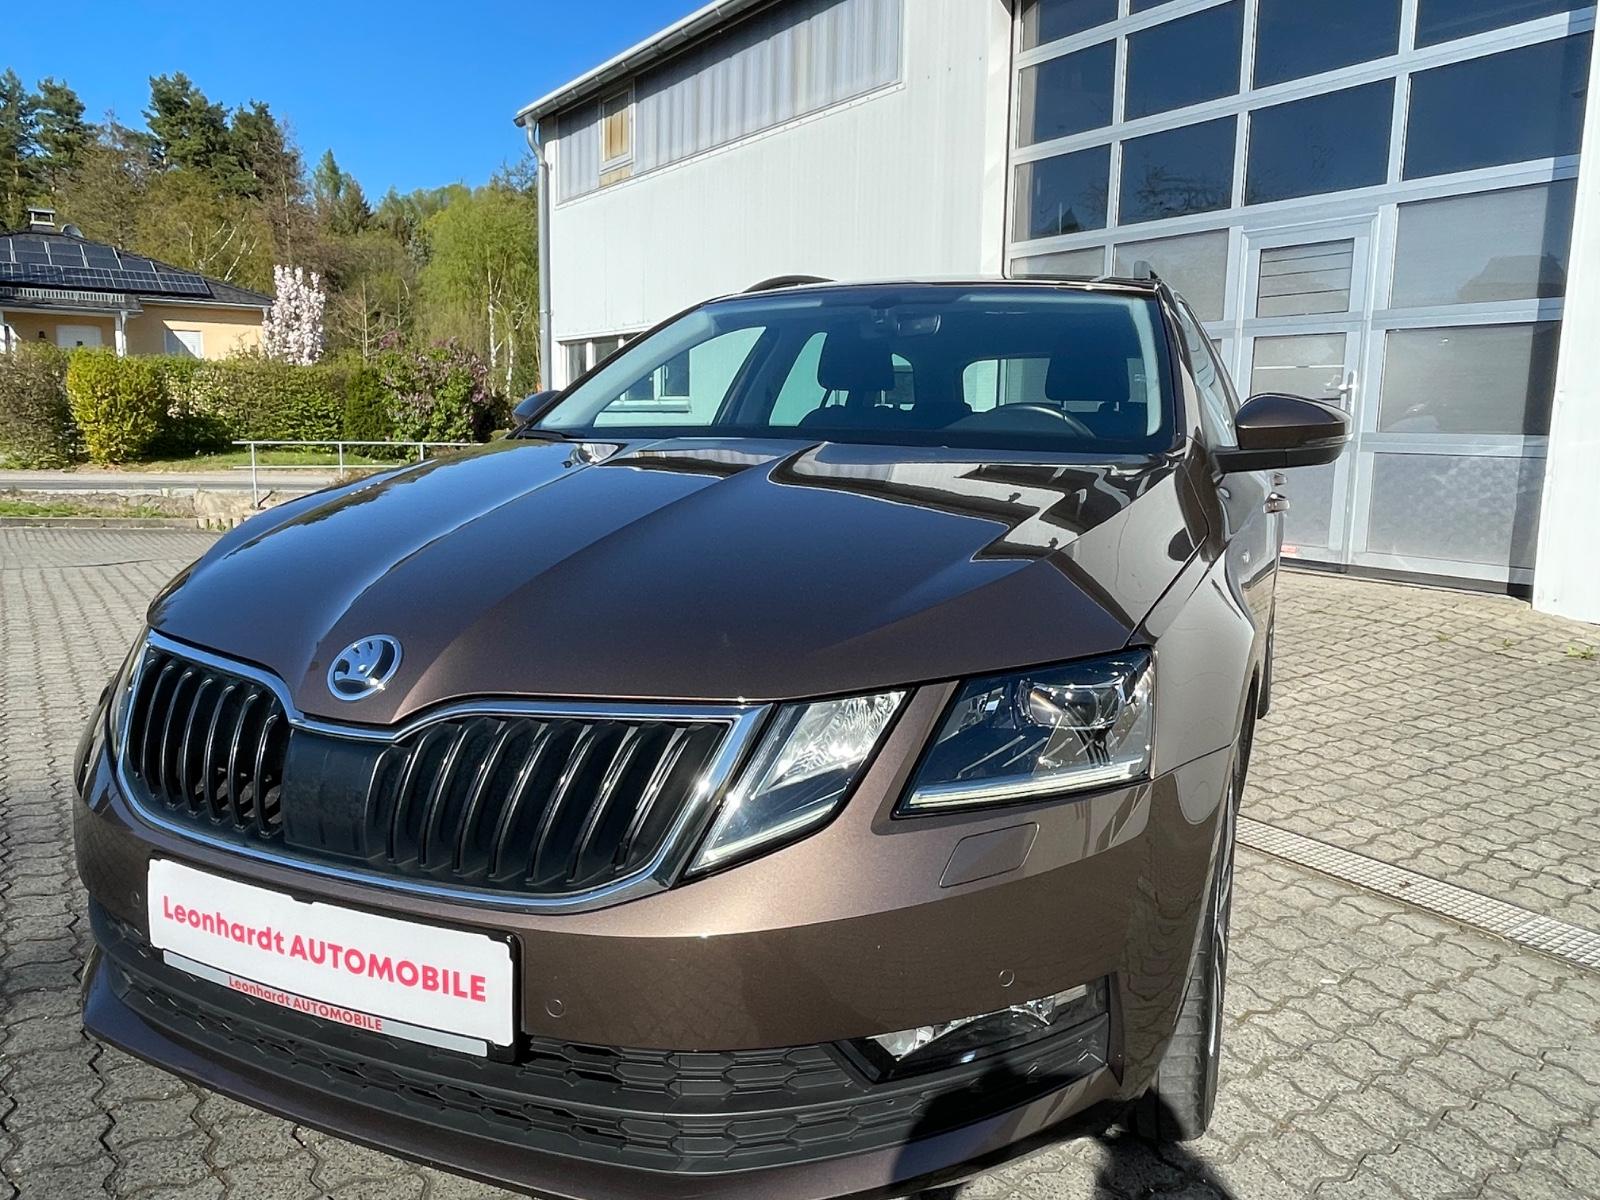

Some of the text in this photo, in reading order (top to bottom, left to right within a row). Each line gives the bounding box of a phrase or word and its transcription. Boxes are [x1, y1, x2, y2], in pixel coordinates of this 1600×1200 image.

[163, 895, 486, 1002] Leonhardt AUTOMOBILE
[228, 975, 383, 1031] Leonhardt AUTOMOBILE
